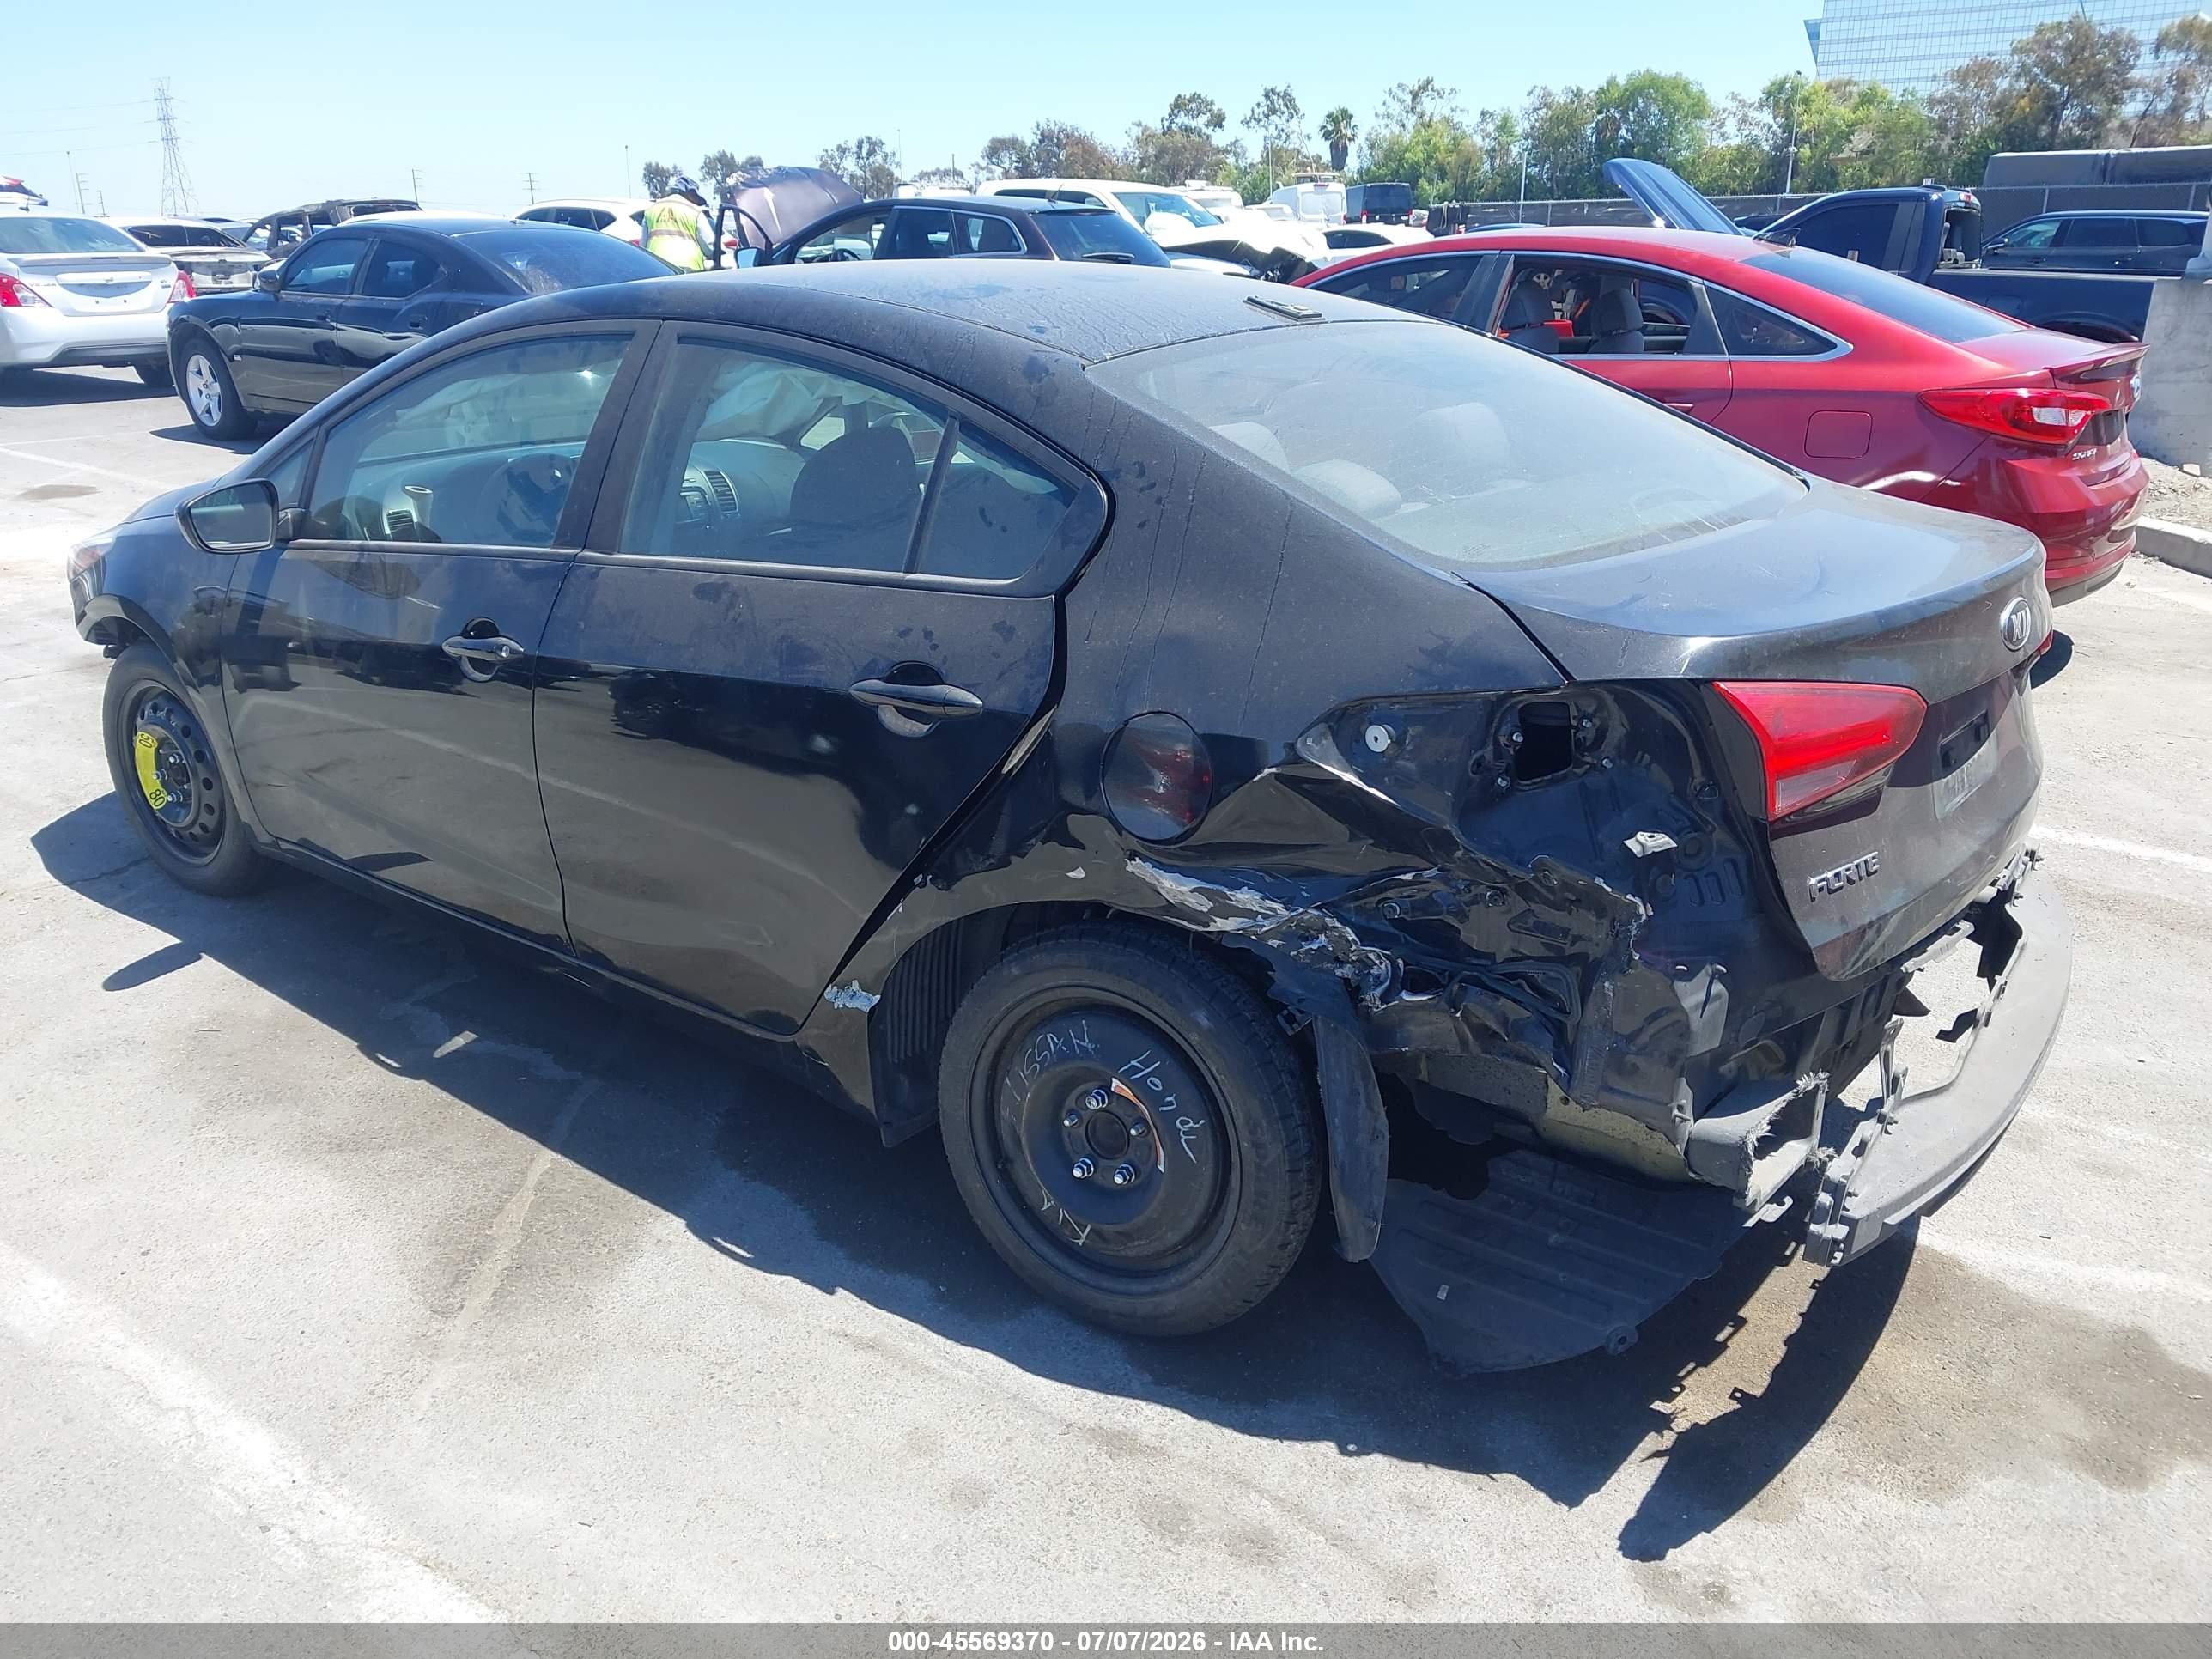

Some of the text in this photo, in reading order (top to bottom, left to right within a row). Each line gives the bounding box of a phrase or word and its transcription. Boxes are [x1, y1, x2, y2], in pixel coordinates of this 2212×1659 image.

[2010, 608, 2027, 641] KI
[149, 788, 166, 808] 80
[1806, 851, 1881, 902] FORTE
